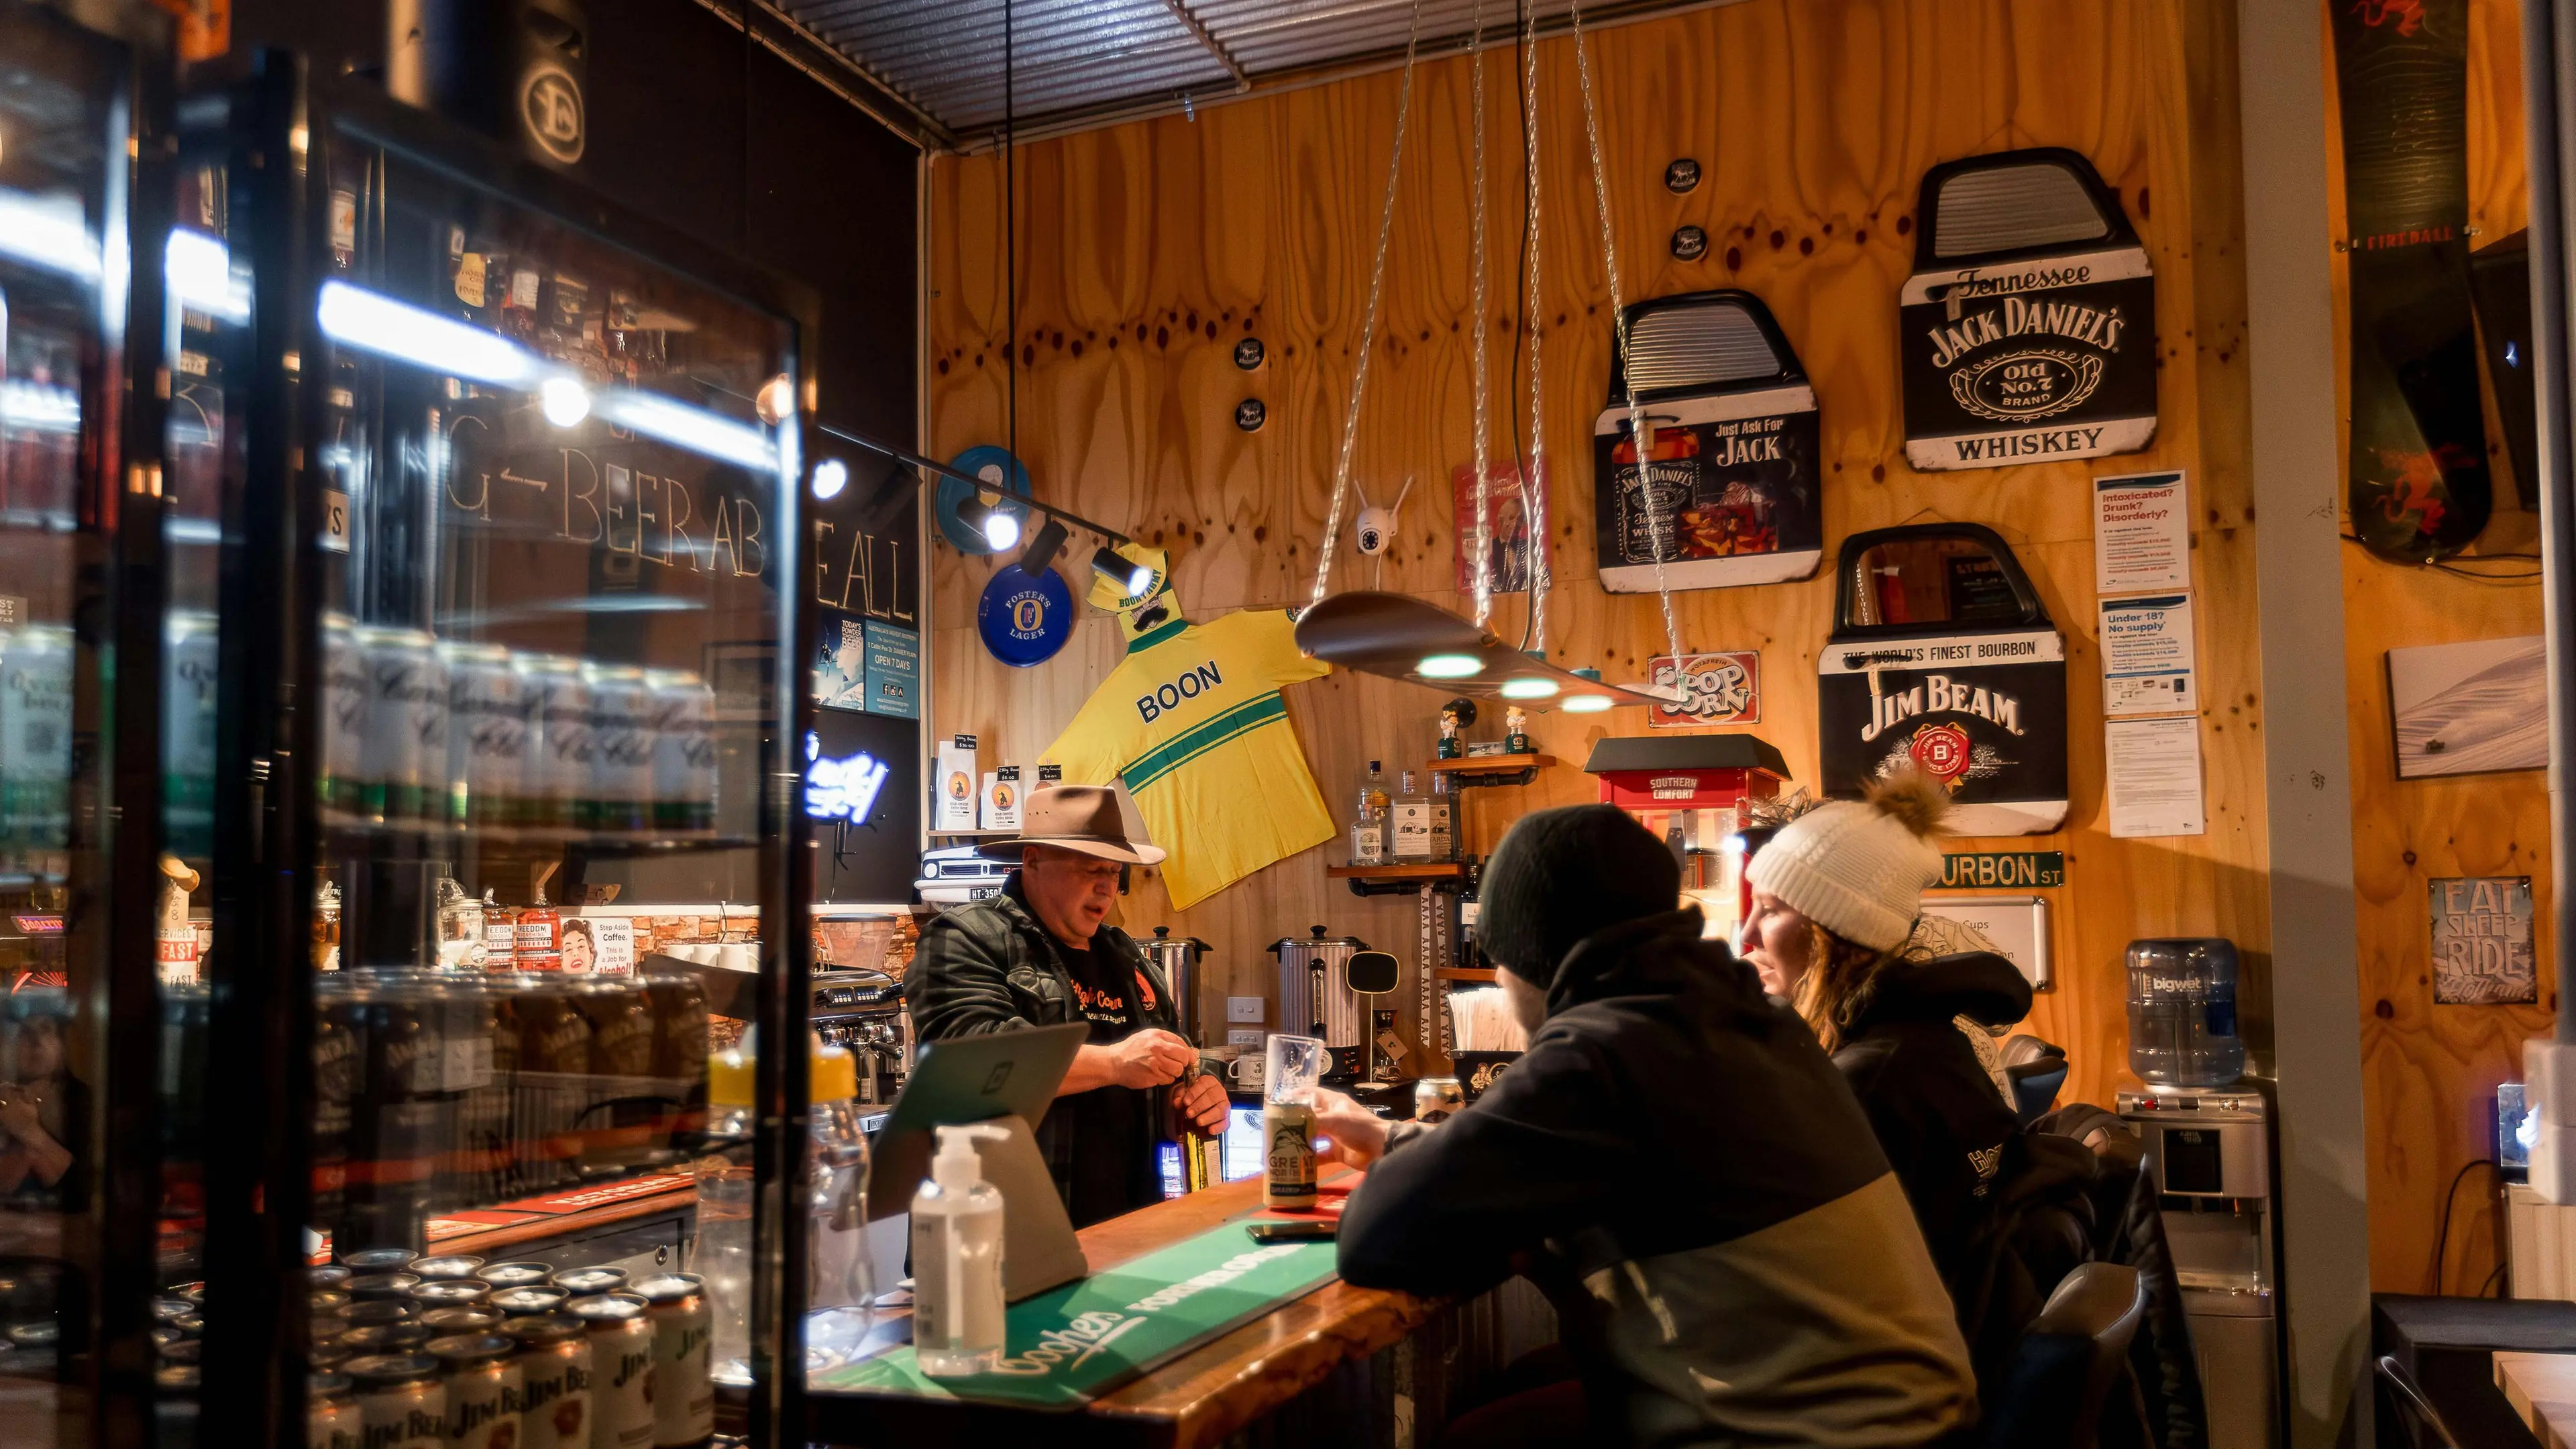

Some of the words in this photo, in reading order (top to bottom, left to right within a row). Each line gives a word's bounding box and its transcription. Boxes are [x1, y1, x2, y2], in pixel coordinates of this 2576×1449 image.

[2367, 225, 2453, 250] FIREBALL
[1957, 266, 2090, 297] Tennessee
[1928, 309, 2003, 368] JACK
[2003, 297, 2125, 350] DANIEL'S
[2004, 363, 2045, 380] Old
[2002, 393, 2051, 406] BRAND
[1715, 423, 1739, 437] Just
[1741, 420, 1761, 434] Ask
[1764, 419, 1784, 431] For
[1716, 435, 1781, 467] JACK
[1954, 427, 2104, 461] WHISKEY
[1650, 468, 1695, 486] DANIEL'S
[2102, 489, 2174, 502] Intoxicated?
[2103, 502, 2143, 513] Drunk?
[2103, 510, 2168, 523] Disorderly?
[556, 448, 699, 573] BEER
[840, 530, 913, 623] ALL
[1631, 525, 1674, 537] WHSK
[1006, 590, 1051, 609] FOSTER'S
[2108, 613, 2141, 623] Under
[2146, 611, 2164, 621] 18?
[1010, 628, 1046, 640] LAGER
[2108, 625, 2123, 633] No
[842, 638, 861, 650] BEER
[1931, 645, 1972, 661] FINEST
[1978, 641, 2035, 658] BOURBON
[875, 654, 891, 667] OPEN
[892, 659, 895, 667] 7
[896, 659, 910, 670] DAYS
[1136, 659, 1224, 724] BOON
[1862, 686, 1923, 743] JIM
[1925, 674, 2018, 737] BEAM
[1923, 739, 1934, 750] JIM
[1936, 735, 1957, 749] BEAM
[1933, 745, 1947, 760] B
[1650, 777, 1697, 789] SOUTHERN
[1653, 789, 1695, 800] COMFORT
[1941, 856, 2036, 885] URBON
[2041, 871, 2061, 884] ST
[2445, 880, 2518, 914] EAT
[2448, 915, 2520, 938] SLEEP
[602, 933, 628, 941] Coffee.
[160, 942, 194, 960] FAST
[2447, 939, 2523, 976] RIDE
[170, 975, 191, 986] FAST
[2153, 977, 2202, 992] bigwet
